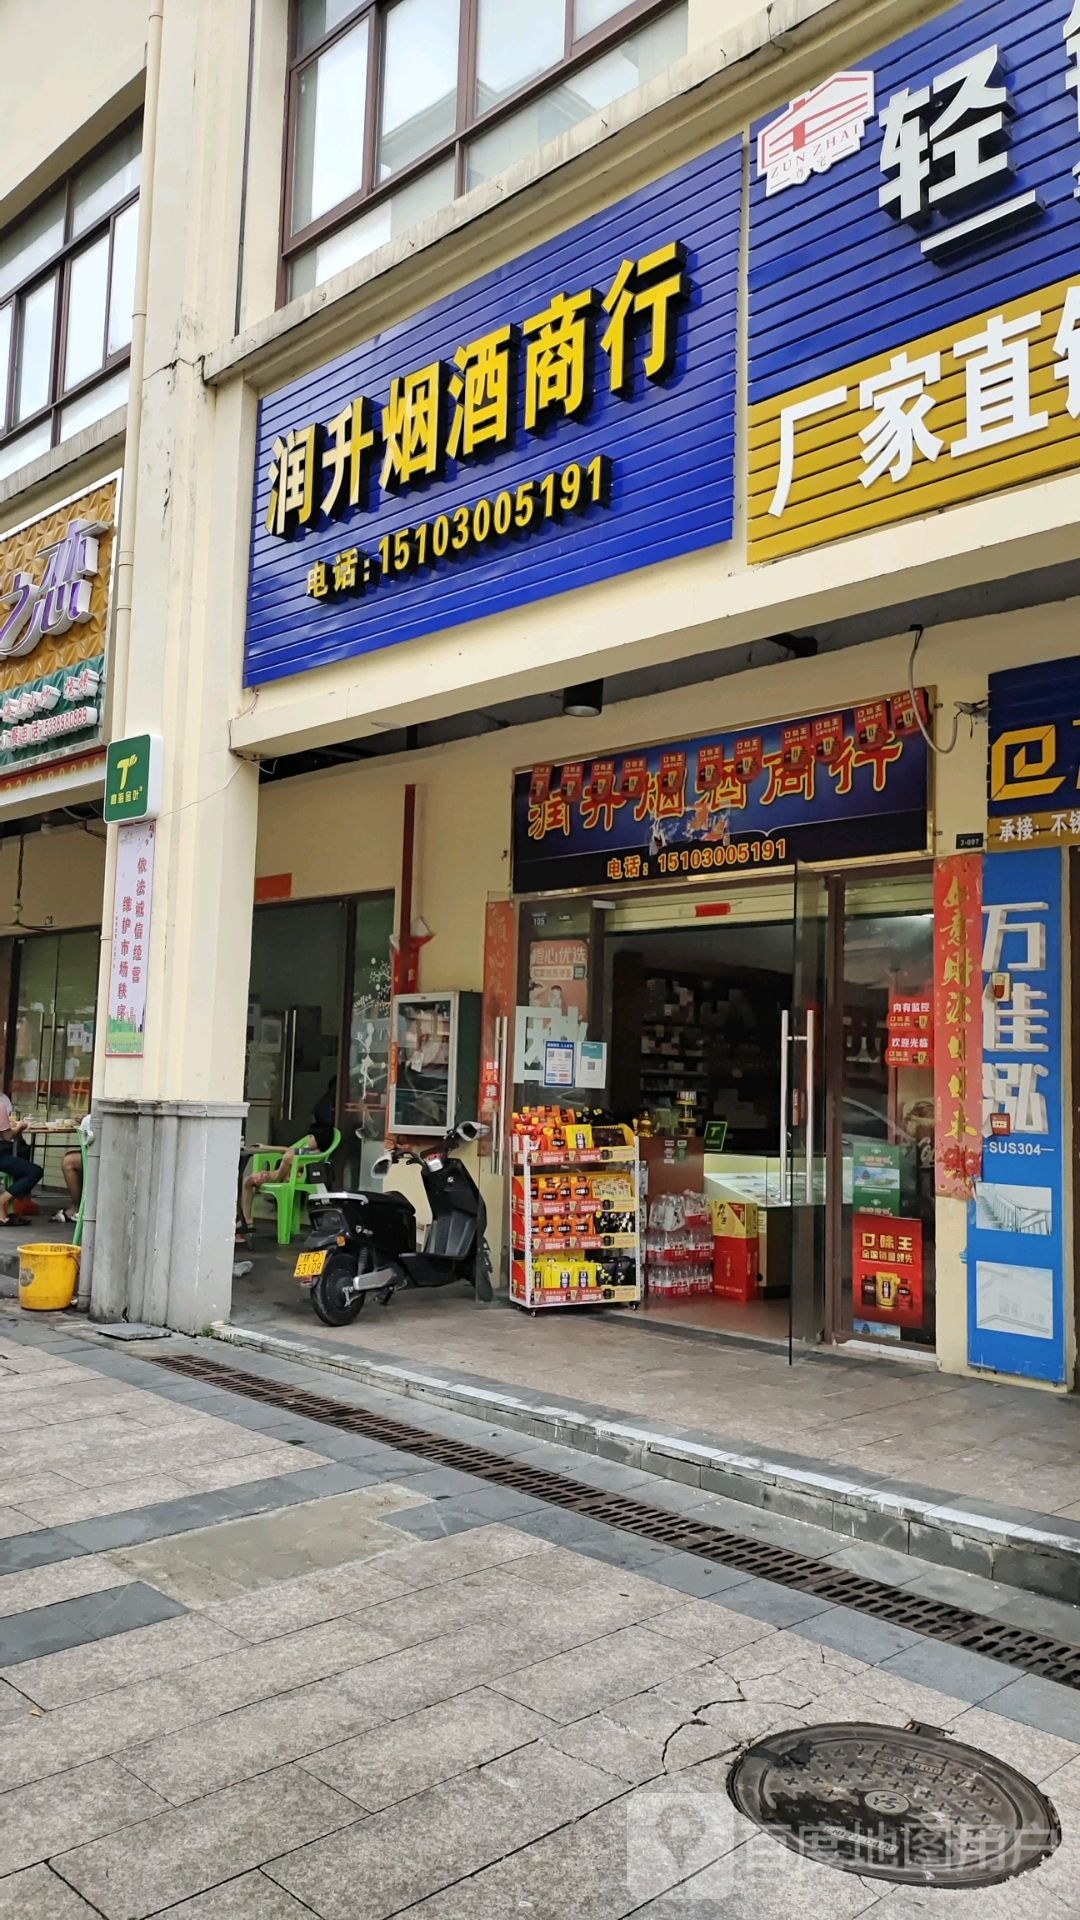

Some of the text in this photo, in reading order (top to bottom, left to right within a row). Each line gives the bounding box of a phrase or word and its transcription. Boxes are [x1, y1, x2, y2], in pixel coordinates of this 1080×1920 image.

[770, 152, 806, 180] ZUN
[813, 123, 858, 157] ZHAI
[265, 239, 684, 537] 润升烟酒商行
[131, 856, 148, 985] 依法诚信经营
[115, 895, 133, 1022] 维护市场秩序
[892, 1002, 931, 1013] 内有监控
[891, 1037, 929, 1049] 欢迎光临
[988, 1141, 1042, 1157] SUS304
[861, 1232, 914, 1252] 口味王
[861, 1249, 914, 1264] 全国销量领先
